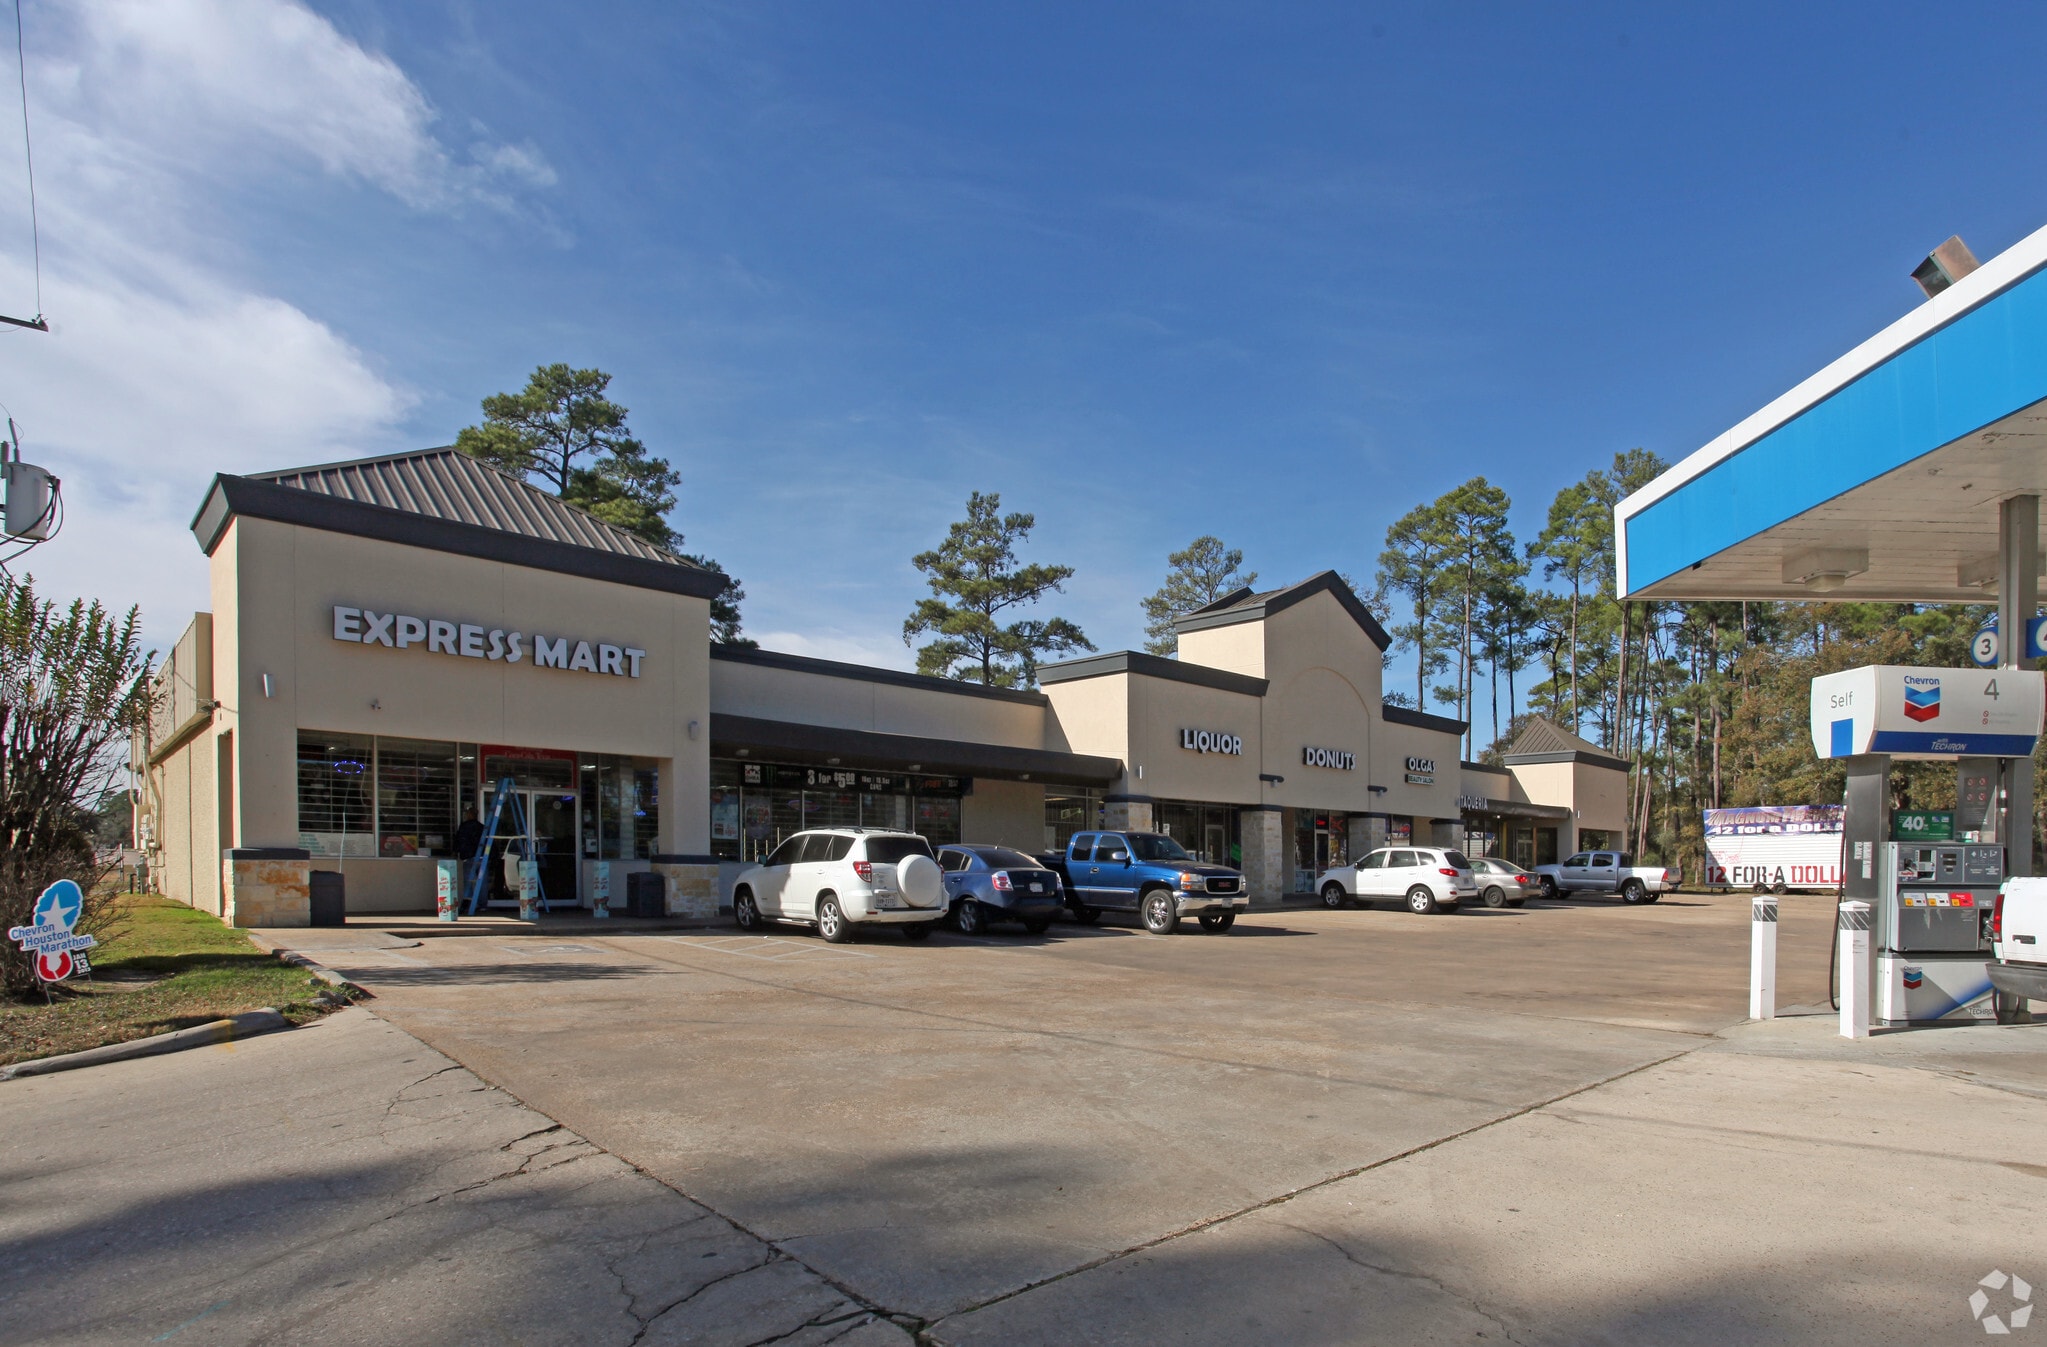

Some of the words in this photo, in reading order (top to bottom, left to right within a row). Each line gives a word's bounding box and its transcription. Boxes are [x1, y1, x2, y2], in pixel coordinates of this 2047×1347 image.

[333, 605, 523, 663] EXPRESS
[533, 635, 646, 678] MART
[1980, 638, 1992, 656] 3
[1904, 676, 1940, 686] Chevron
[1984, 678, 2000, 701] 4
[1830, 691, 1854, 710] Self
[1182, 728, 1243, 756] LIQUOR
[1931, 742, 1967, 752] TECHRON
[1304, 747, 1357, 771] DONUTS
[1408, 757, 1436, 773] OLGAS
[807, 769, 815, 785] 3
[818, 772, 832, 784] for
[1408, 775, 1422, 783] BEAUTY
[1460, 794, 1489, 811] TAQUERIA
[1708, 810, 1782, 826] MAGNUM
[1737, 825, 1766, 834] for
[1769, 825, 1782, 833] a
[1707, 866, 1727, 883] 12
[11, 924, 55, 939] Chevron
[25, 931, 70, 947] Houston
[41, 936, 91, 954] Marathon
[73, 952, 87, 961] JAN
[74, 959, 89, 970] 13
[1969, 1007, 1993, 1016] TECHRO
